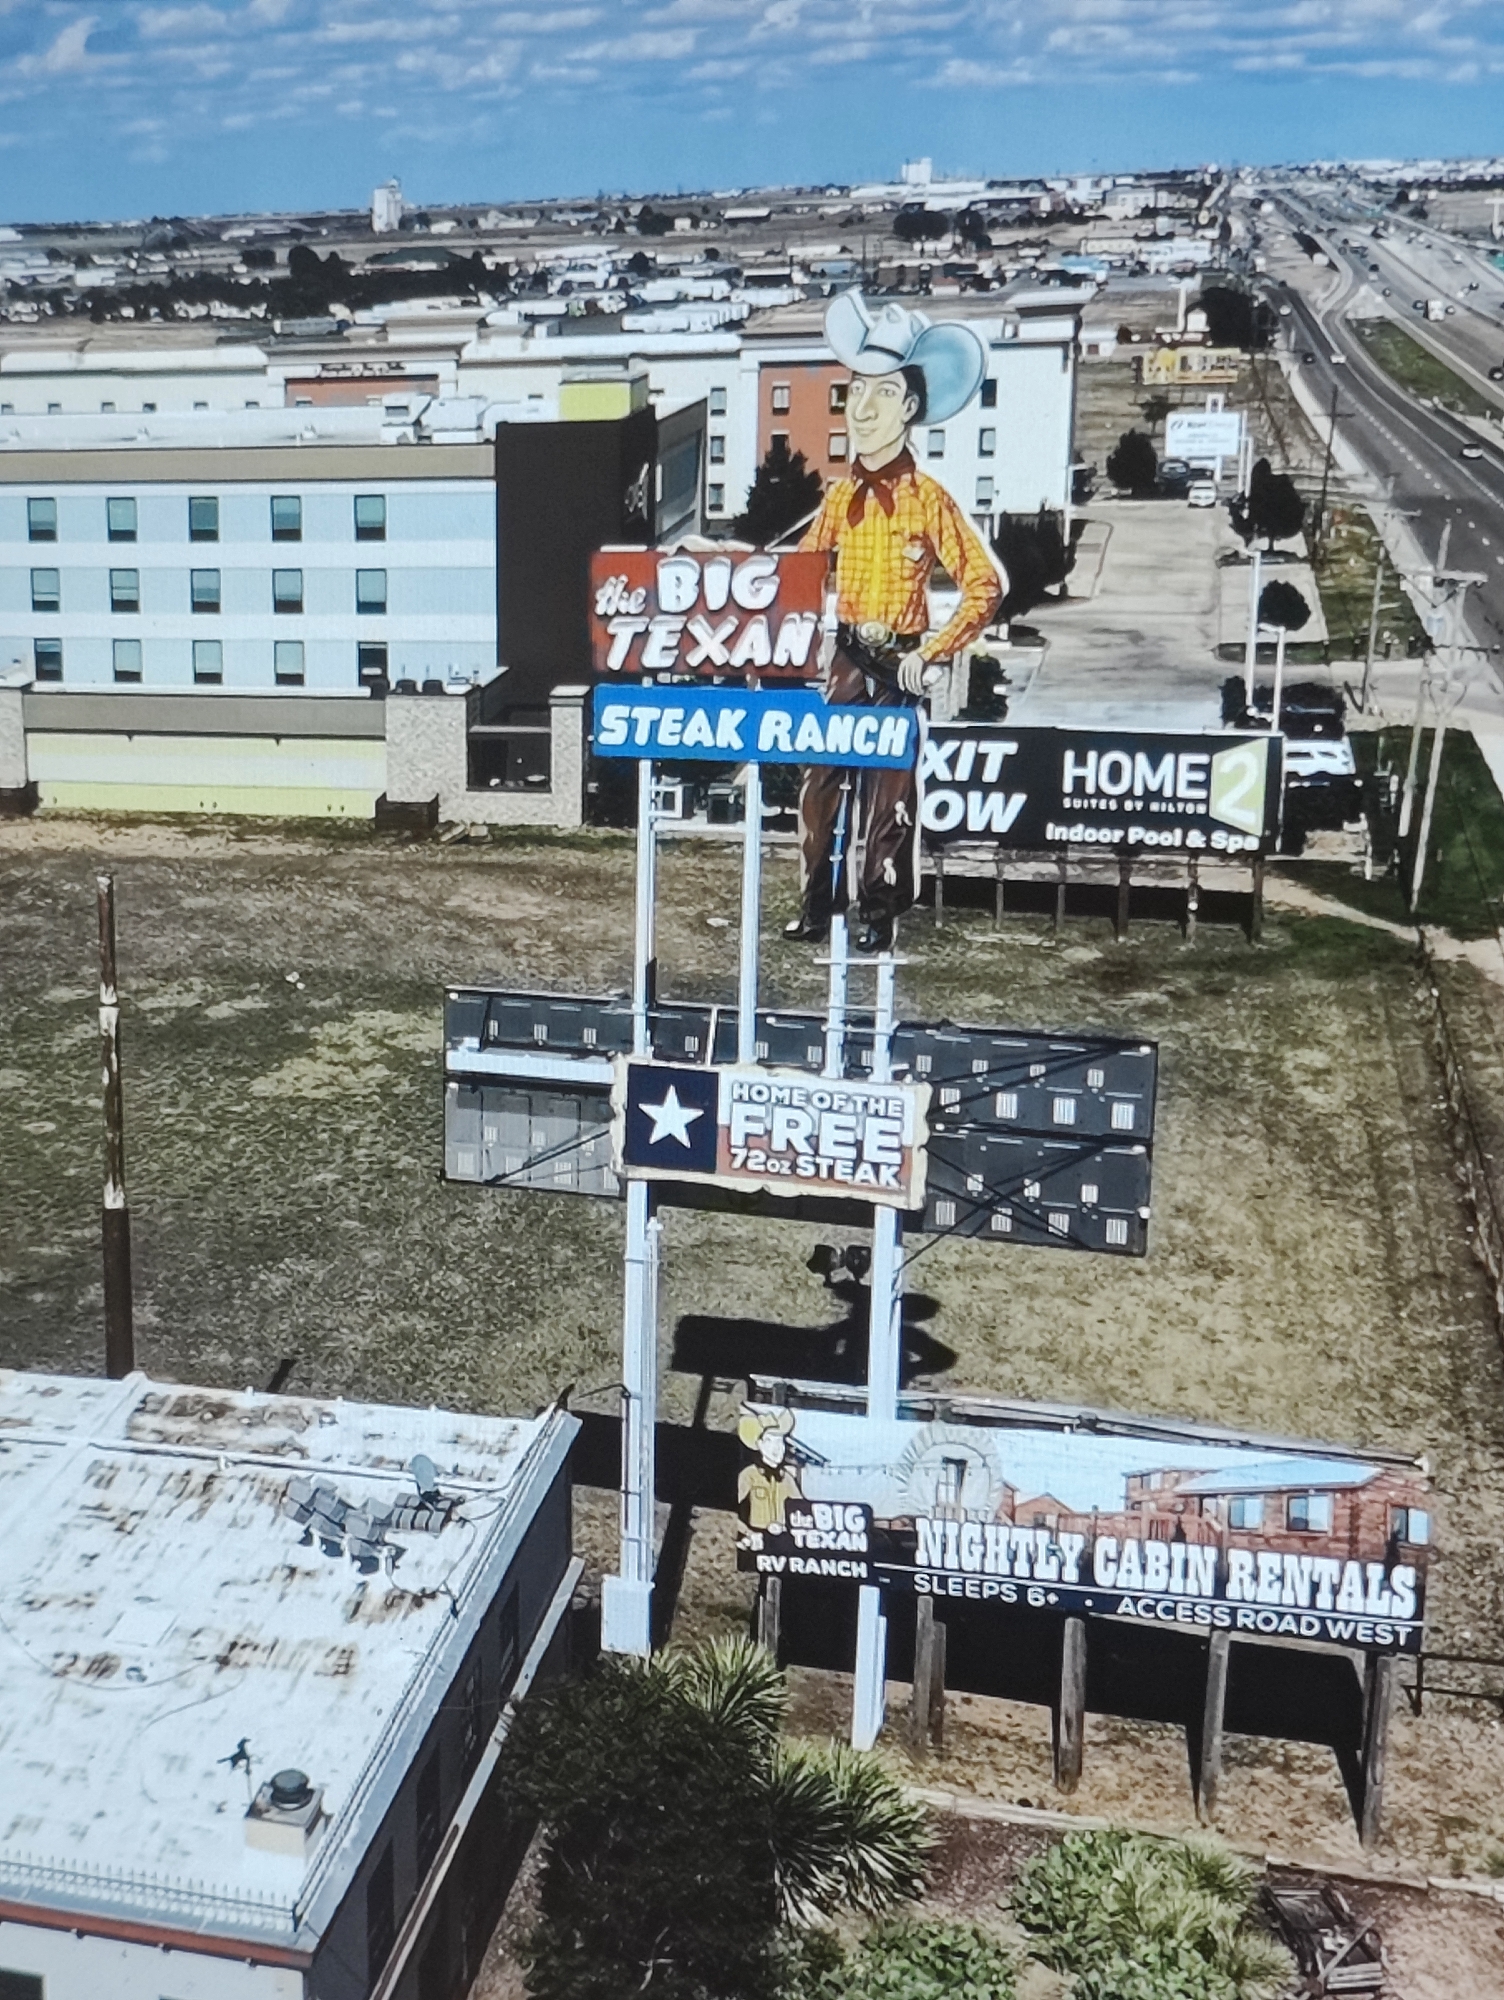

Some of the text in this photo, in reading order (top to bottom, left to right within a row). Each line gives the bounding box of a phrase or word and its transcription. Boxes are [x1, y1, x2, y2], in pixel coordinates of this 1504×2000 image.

[595, 554, 780, 616] the BIG
[606, 611, 819, 671] TEXAN
[597, 704, 910, 757] STEAK RANCH
[920, 740, 1019, 783] XIT
[920, 789, 1028, 833] OW
[1062, 797, 1207, 815] SUITES BY HILTON
[1045, 821, 1260, 854] Indoor Pool & Spa
[732, 1081, 904, 1117] HOME OF THE
[730, 1103, 902, 1164] FREE
[795, 1154, 902, 1187] STEAK
[789, 1503, 867, 1533] the BIG
[790, 1529, 869, 1552] TEXAN
[756, 1554, 869, 1578] RV RANCH
[914, 1517, 1417, 1619] NIGHTLY CABIN RENTALS
[913, 1573, 1413, 1647] SLEEPS 6+ ACCESS ROAD WEST
